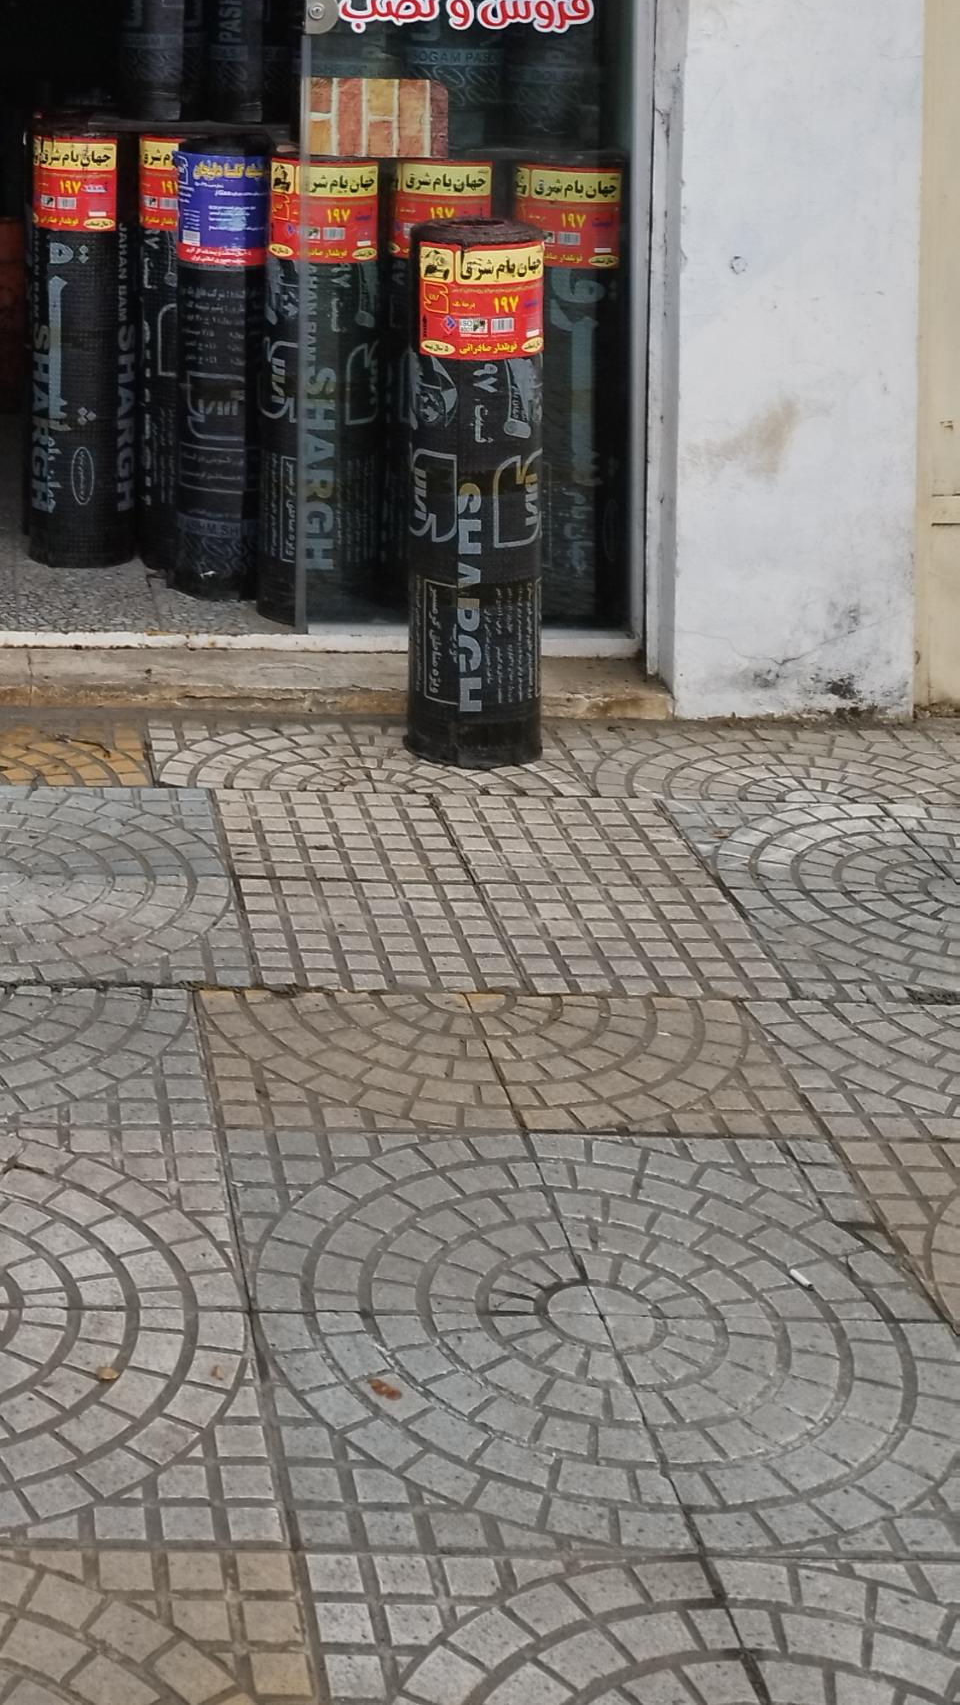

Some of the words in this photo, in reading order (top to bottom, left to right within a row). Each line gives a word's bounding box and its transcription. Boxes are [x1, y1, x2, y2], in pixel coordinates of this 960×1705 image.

[60, 181, 81, 194] ۱۹۷
[329, 175, 348, 193] بام
[350, 175, 375, 193] جهان
[405, 172, 431, 190] شرق
[433, 174, 452, 191] بام
[453, 174, 486, 193] جهان
[534, 179, 562, 196] شرق
[564, 180, 584, 197] بام
[586, 180, 617, 198] جهان
[327, 208, 351, 223] ۱۹۷
[431, 206, 455, 218] ۱۹۷
[561, 213, 586, 228] ۱۹۷
[496, 257, 516, 279] بام
[493, 296, 519, 313] ۱۹۷
[472, 364, 499, 393] ۹۷
[117, 324, 136, 513] SHARGH
[306, 366, 337, 571] SHARGH
